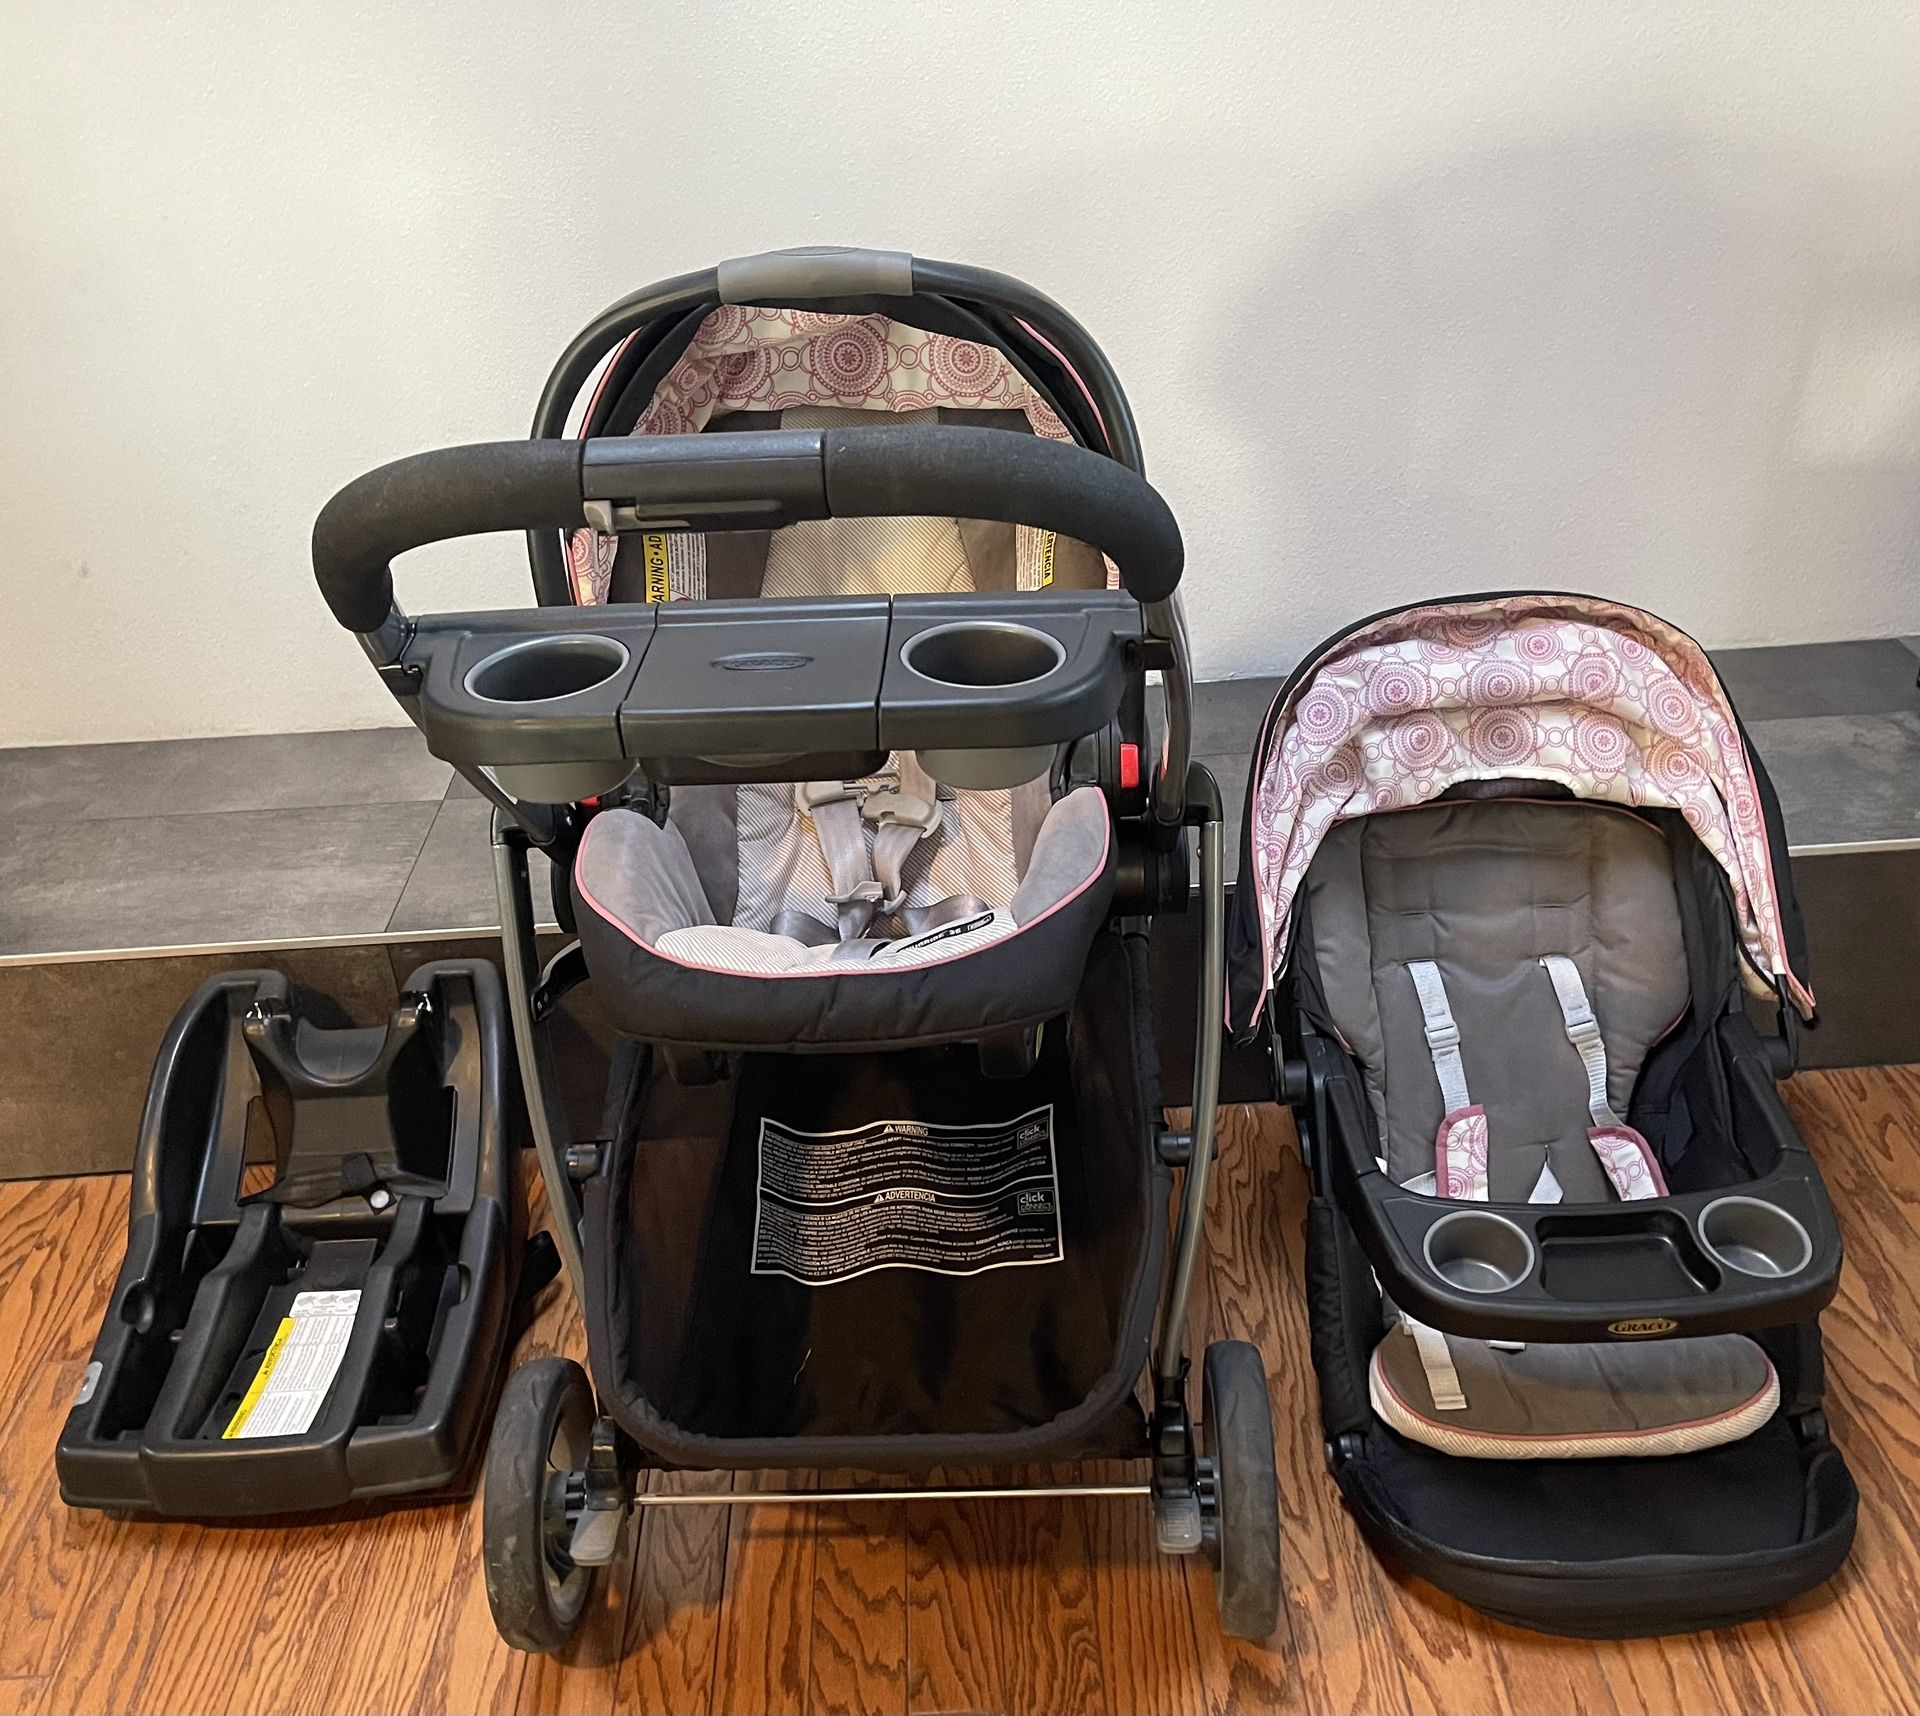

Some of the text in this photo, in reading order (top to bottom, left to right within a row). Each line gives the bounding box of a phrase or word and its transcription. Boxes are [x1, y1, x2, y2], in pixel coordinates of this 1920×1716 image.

[894, 1125, 929, 1136] WARNING
[1020, 1125, 1040, 1139] click
[885, 1190, 936, 1203] ADVERTENCIA
[1020, 1192, 1044, 1203] click
[1615, 1322, 1671, 1332] GRACO
